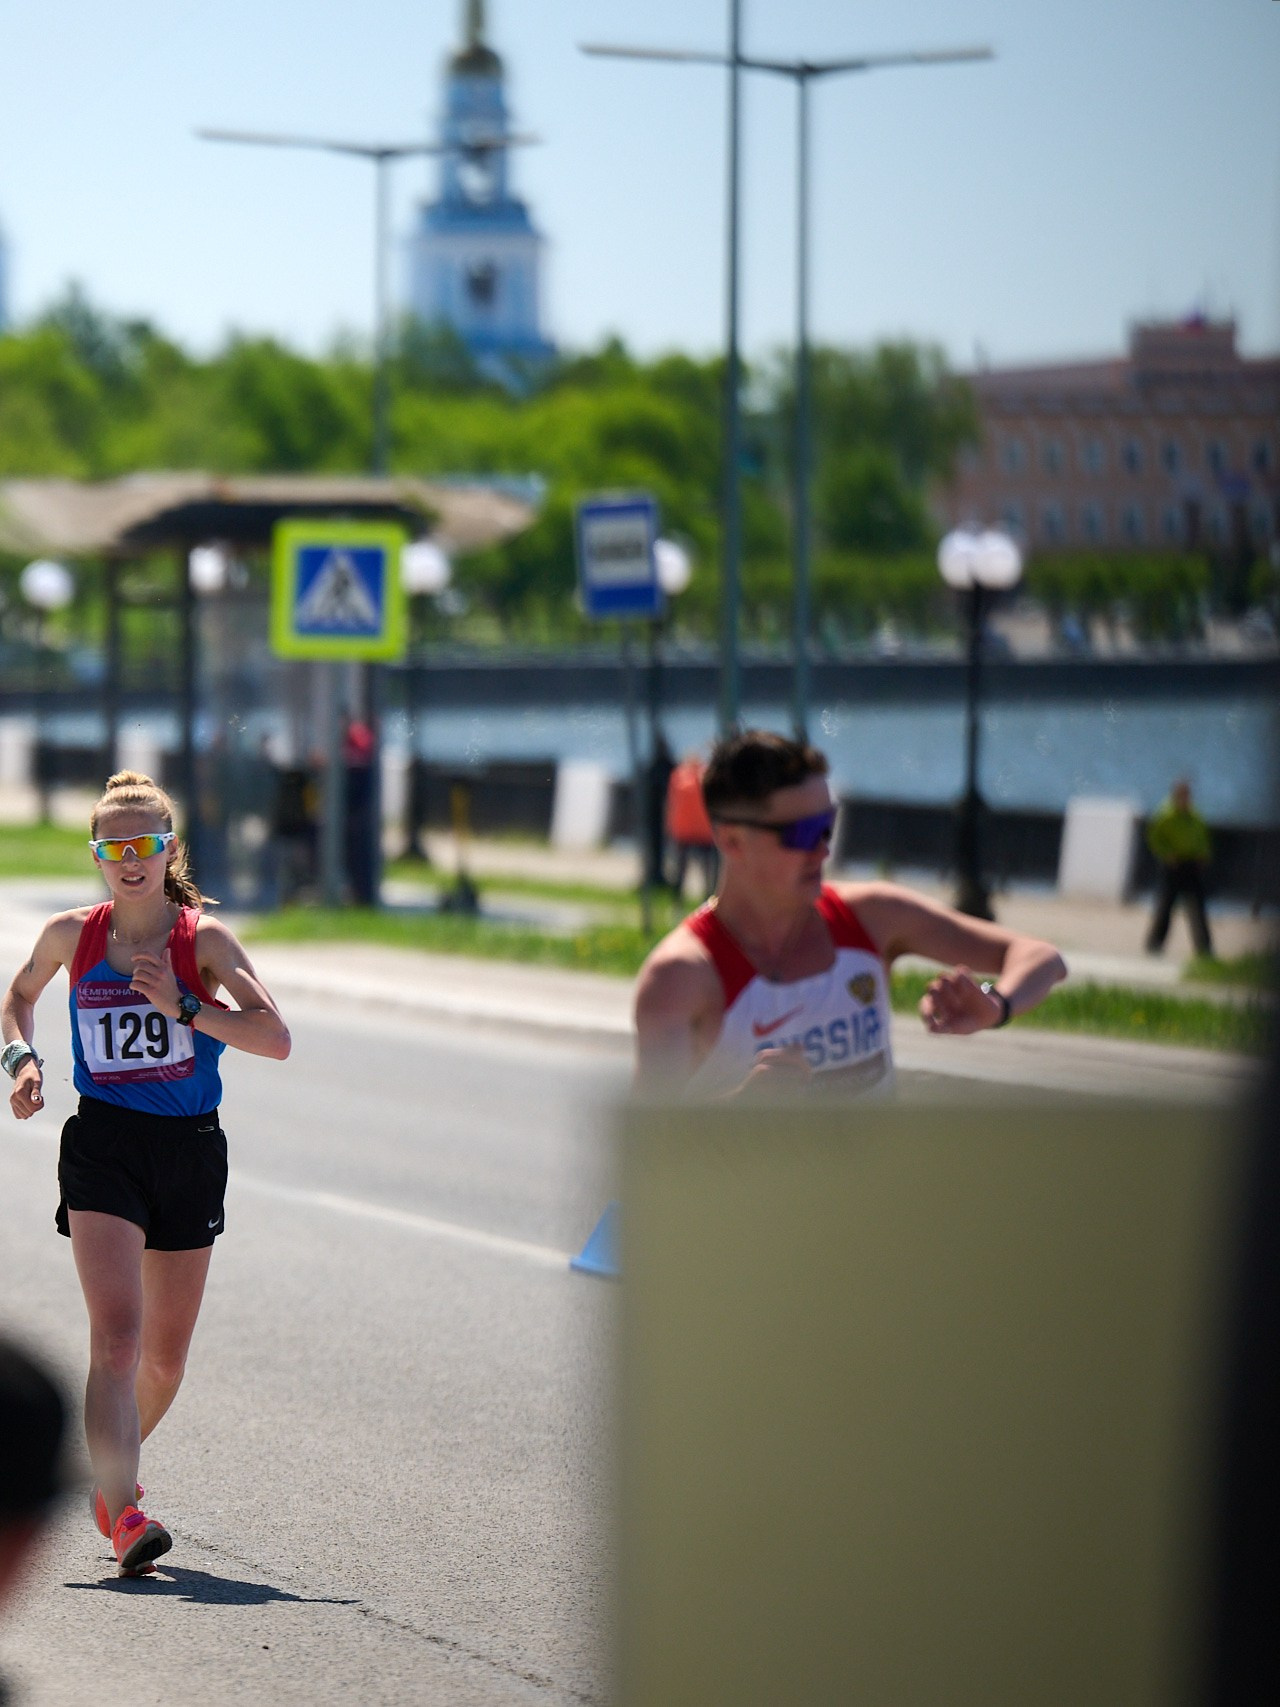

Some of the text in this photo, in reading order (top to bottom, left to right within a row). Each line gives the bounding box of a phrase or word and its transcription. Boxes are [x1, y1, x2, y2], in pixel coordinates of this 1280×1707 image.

[78, 988, 135, 996] ЧЕМПИОНАТ
[98, 1011, 170, 1060] 129
[757, 1006, 881, 1067] SSIA
